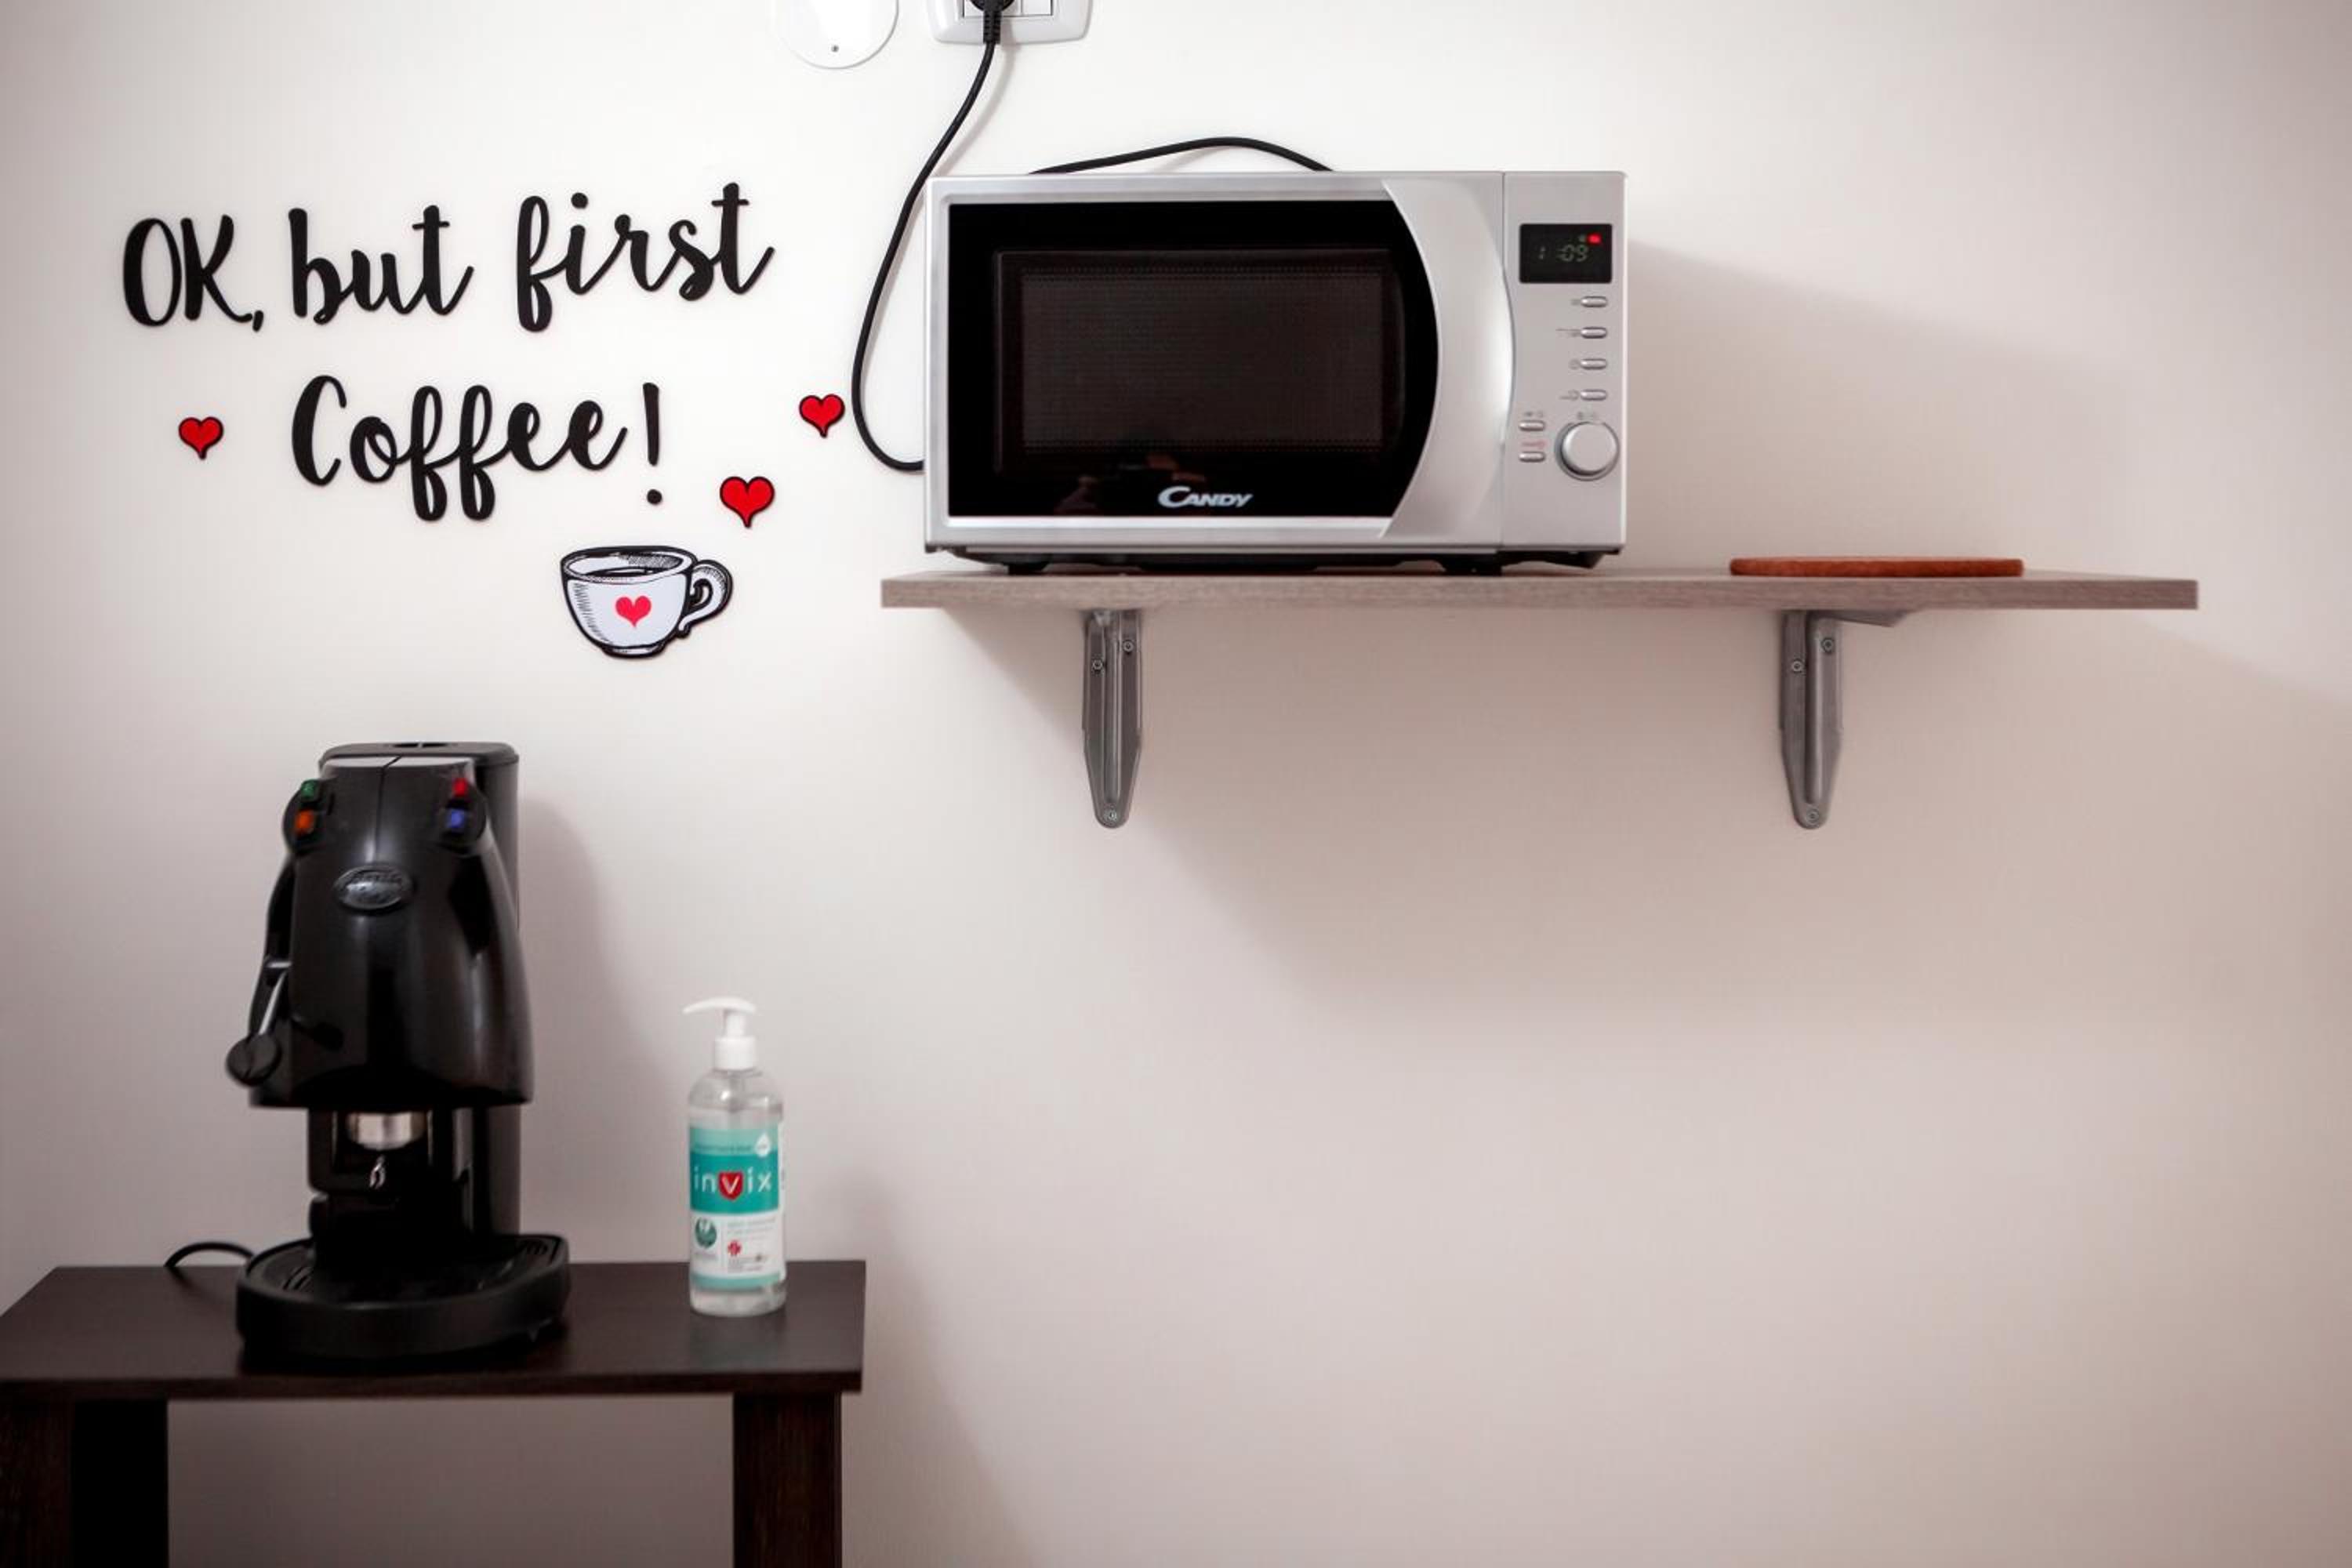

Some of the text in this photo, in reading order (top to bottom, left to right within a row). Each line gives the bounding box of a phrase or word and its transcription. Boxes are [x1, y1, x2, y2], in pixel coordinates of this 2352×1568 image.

[122, 183, 775, 332] OK, but first
[292, 375, 662, 522] Coffee!
[1157, 485, 1254, 509] CANDY
[693, 1165, 772, 1196] invix
